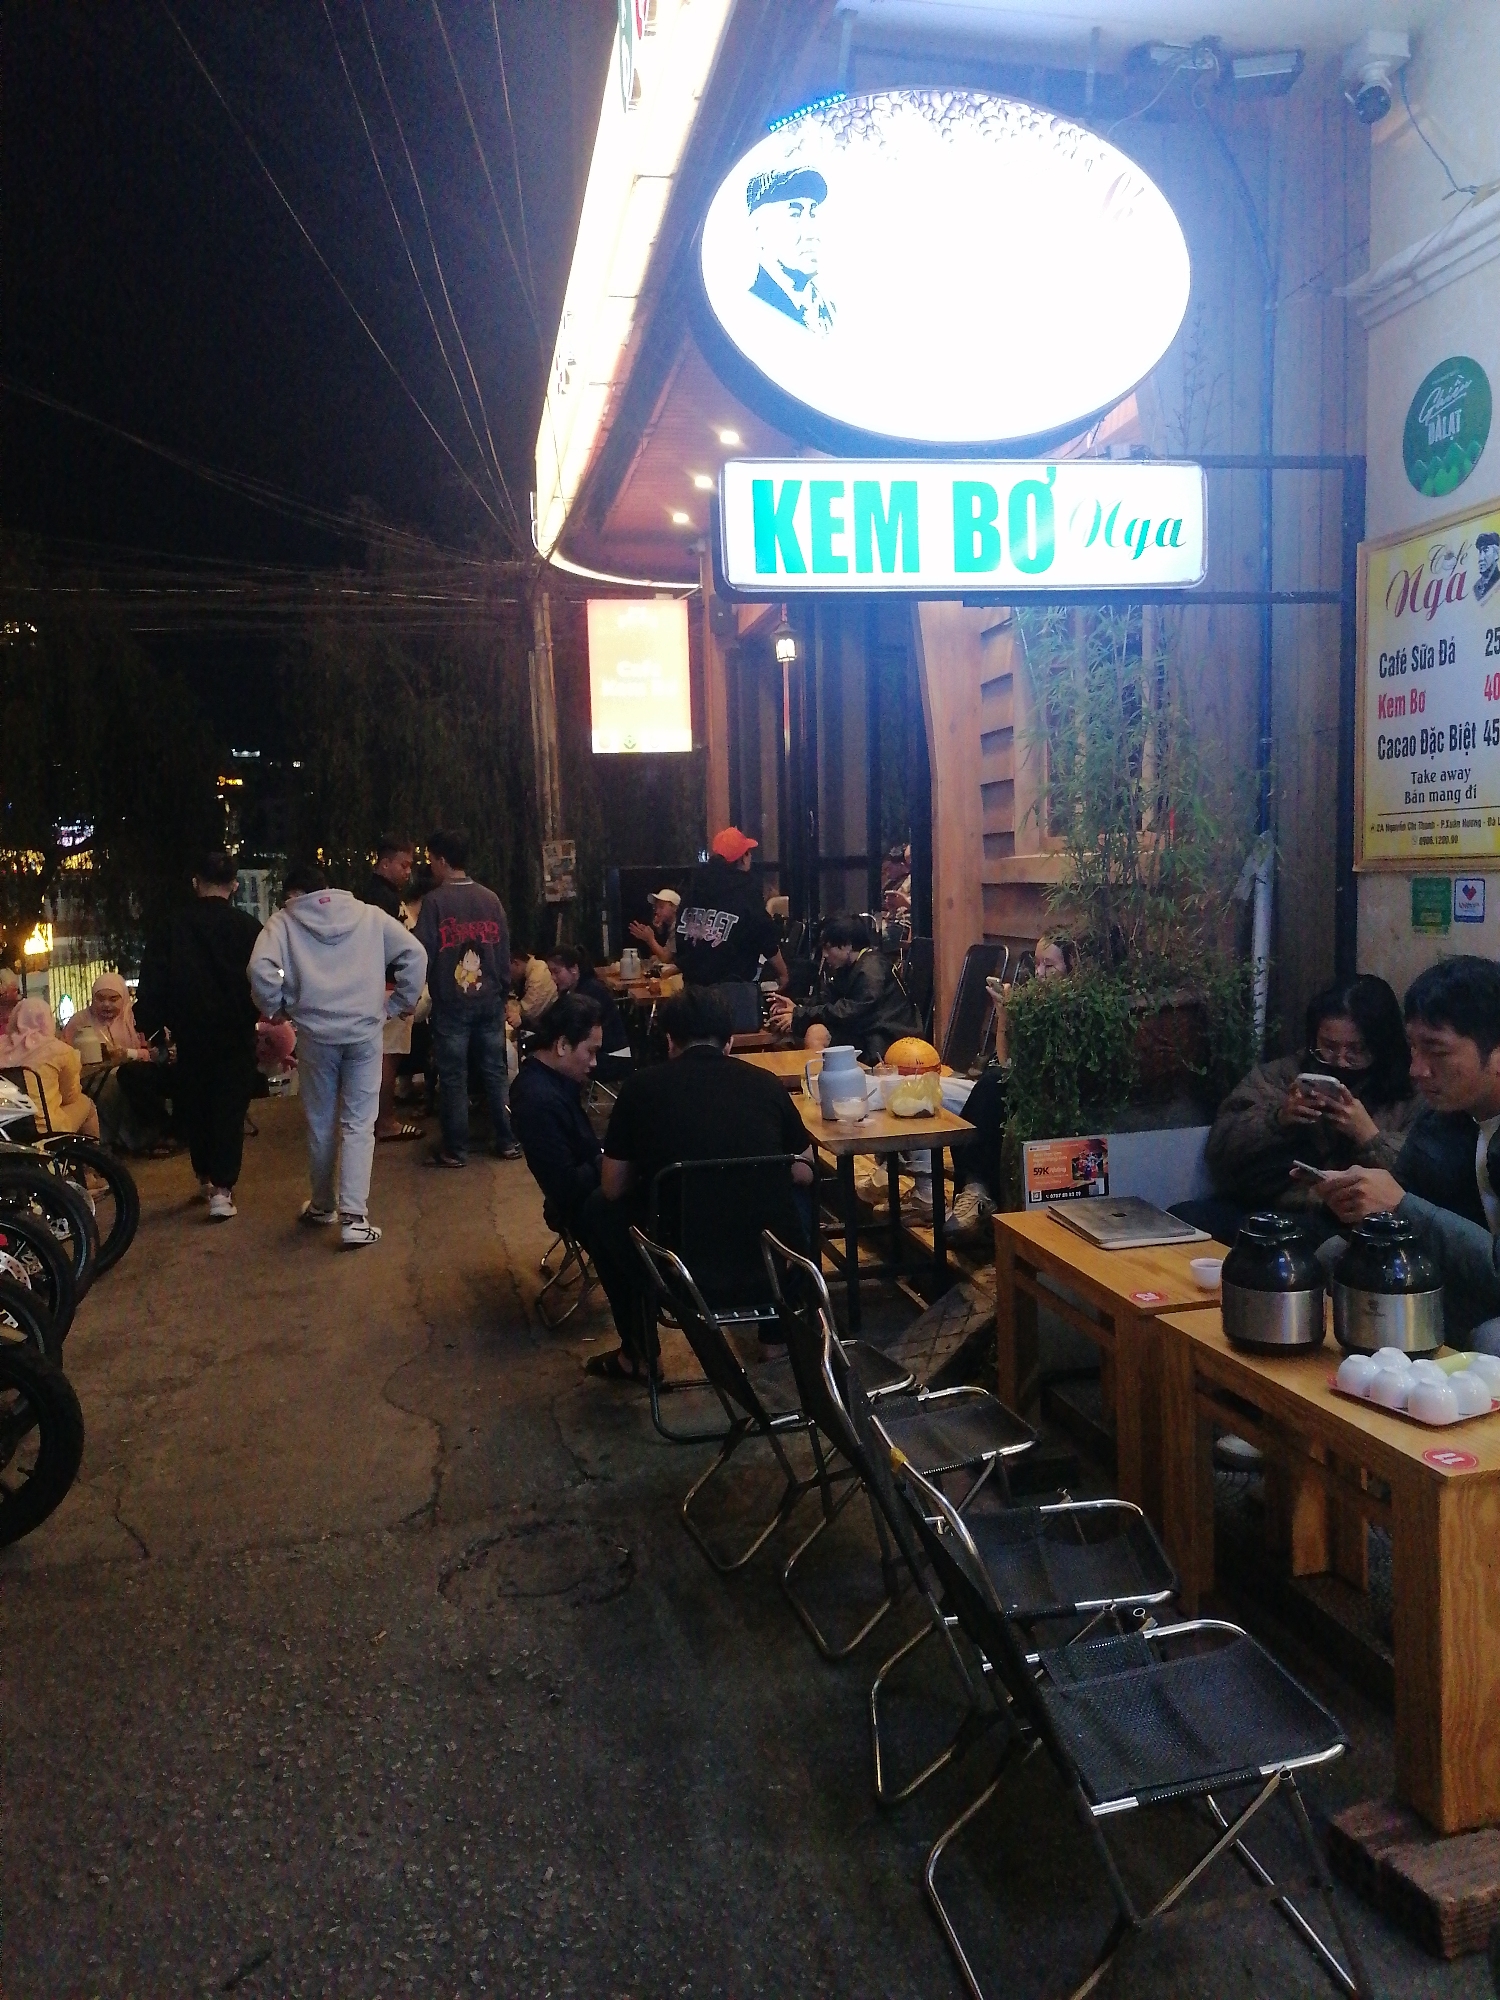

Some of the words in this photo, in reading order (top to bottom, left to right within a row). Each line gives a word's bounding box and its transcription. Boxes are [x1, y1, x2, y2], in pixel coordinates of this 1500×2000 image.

[752, 480, 920, 573] KEM
[952, 466, 1057, 574] BƠ
[1068, 498, 1187, 560] Nga
[1386, 563, 1469, 621] Nga
[1379, 647, 1407, 679] Café
[1411, 643, 1435, 672] Sữa
[1439, 636, 1455, 666] Đá
[1378, 693, 1405, 719] Kem
[1377, 735, 1416, 761] Cacao
[1420, 726, 1444, 760] Đặc
[1449, 721, 1476, 755] Biệt
[1411, 769, 1436, 784] Take
[1440, 768, 1471, 783] away
[1404, 789, 1425, 804] Bán
[1429, 789, 1461, 803] mang
